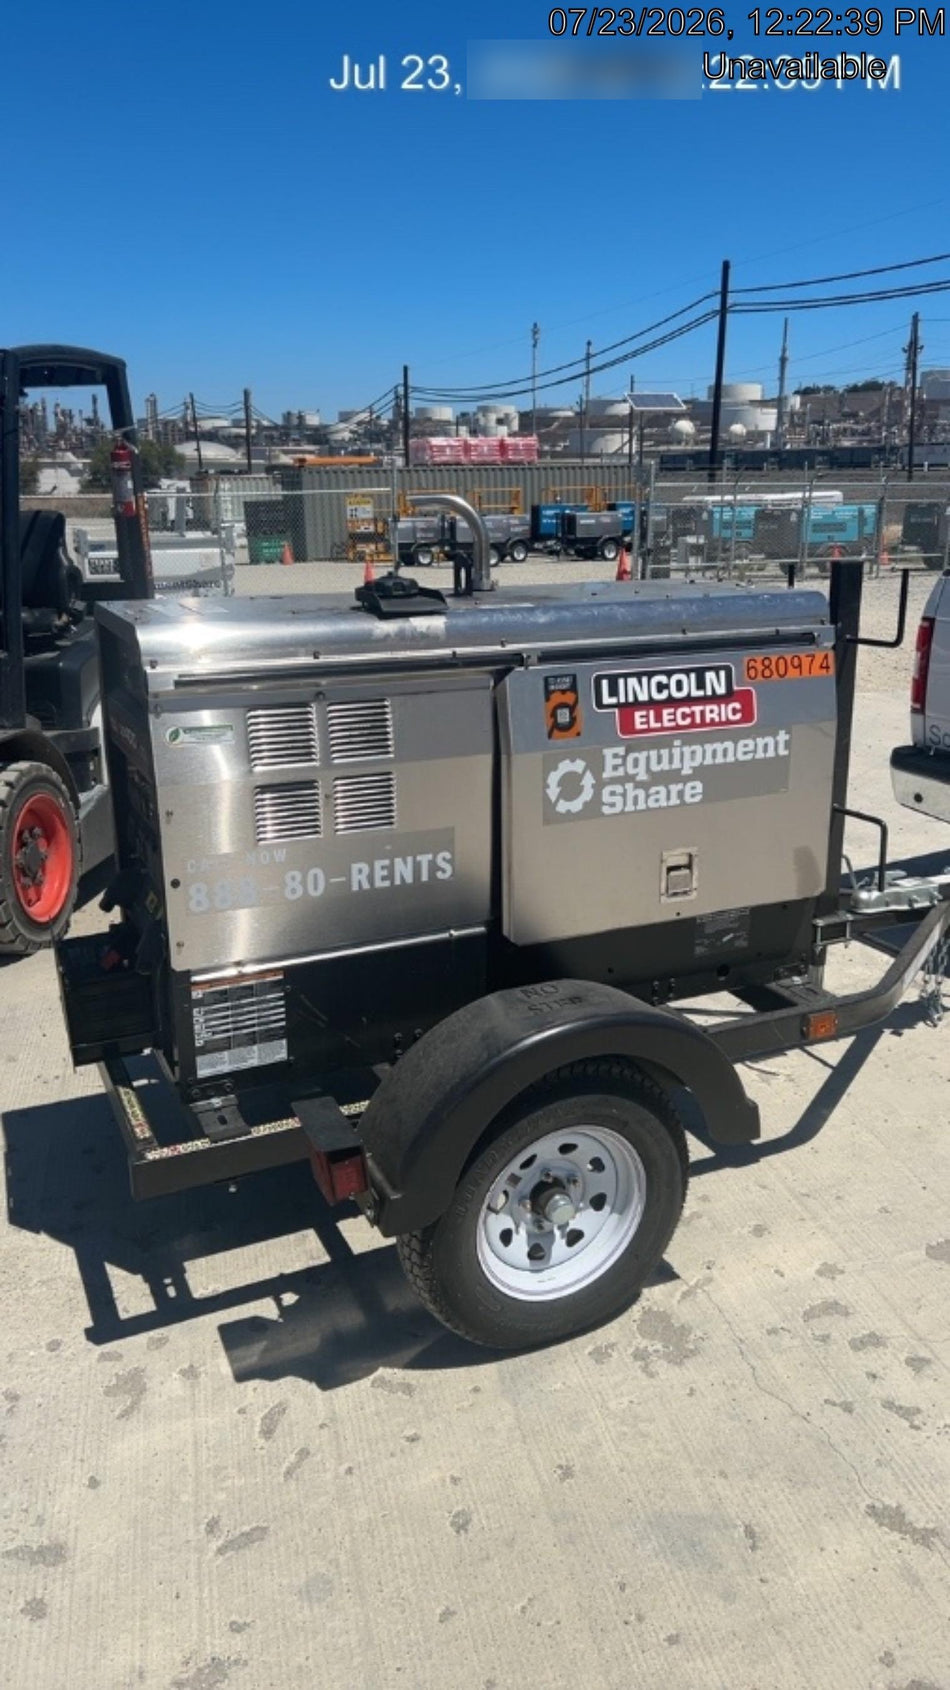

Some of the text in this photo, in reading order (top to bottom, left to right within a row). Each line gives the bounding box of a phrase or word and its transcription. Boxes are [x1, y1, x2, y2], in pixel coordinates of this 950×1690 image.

[746, 653, 831, 681] 680974
[600, 669, 727, 705] LINCOLN
[634, 702, 743, 730] ELECTRIC
[601, 729, 790, 780] Equipment
[601, 779, 704, 815] Share
[245, 848, 287, 865] NOW
[520, 983, 560, 999] NO
[528, 995, 583, 1016] STEP
